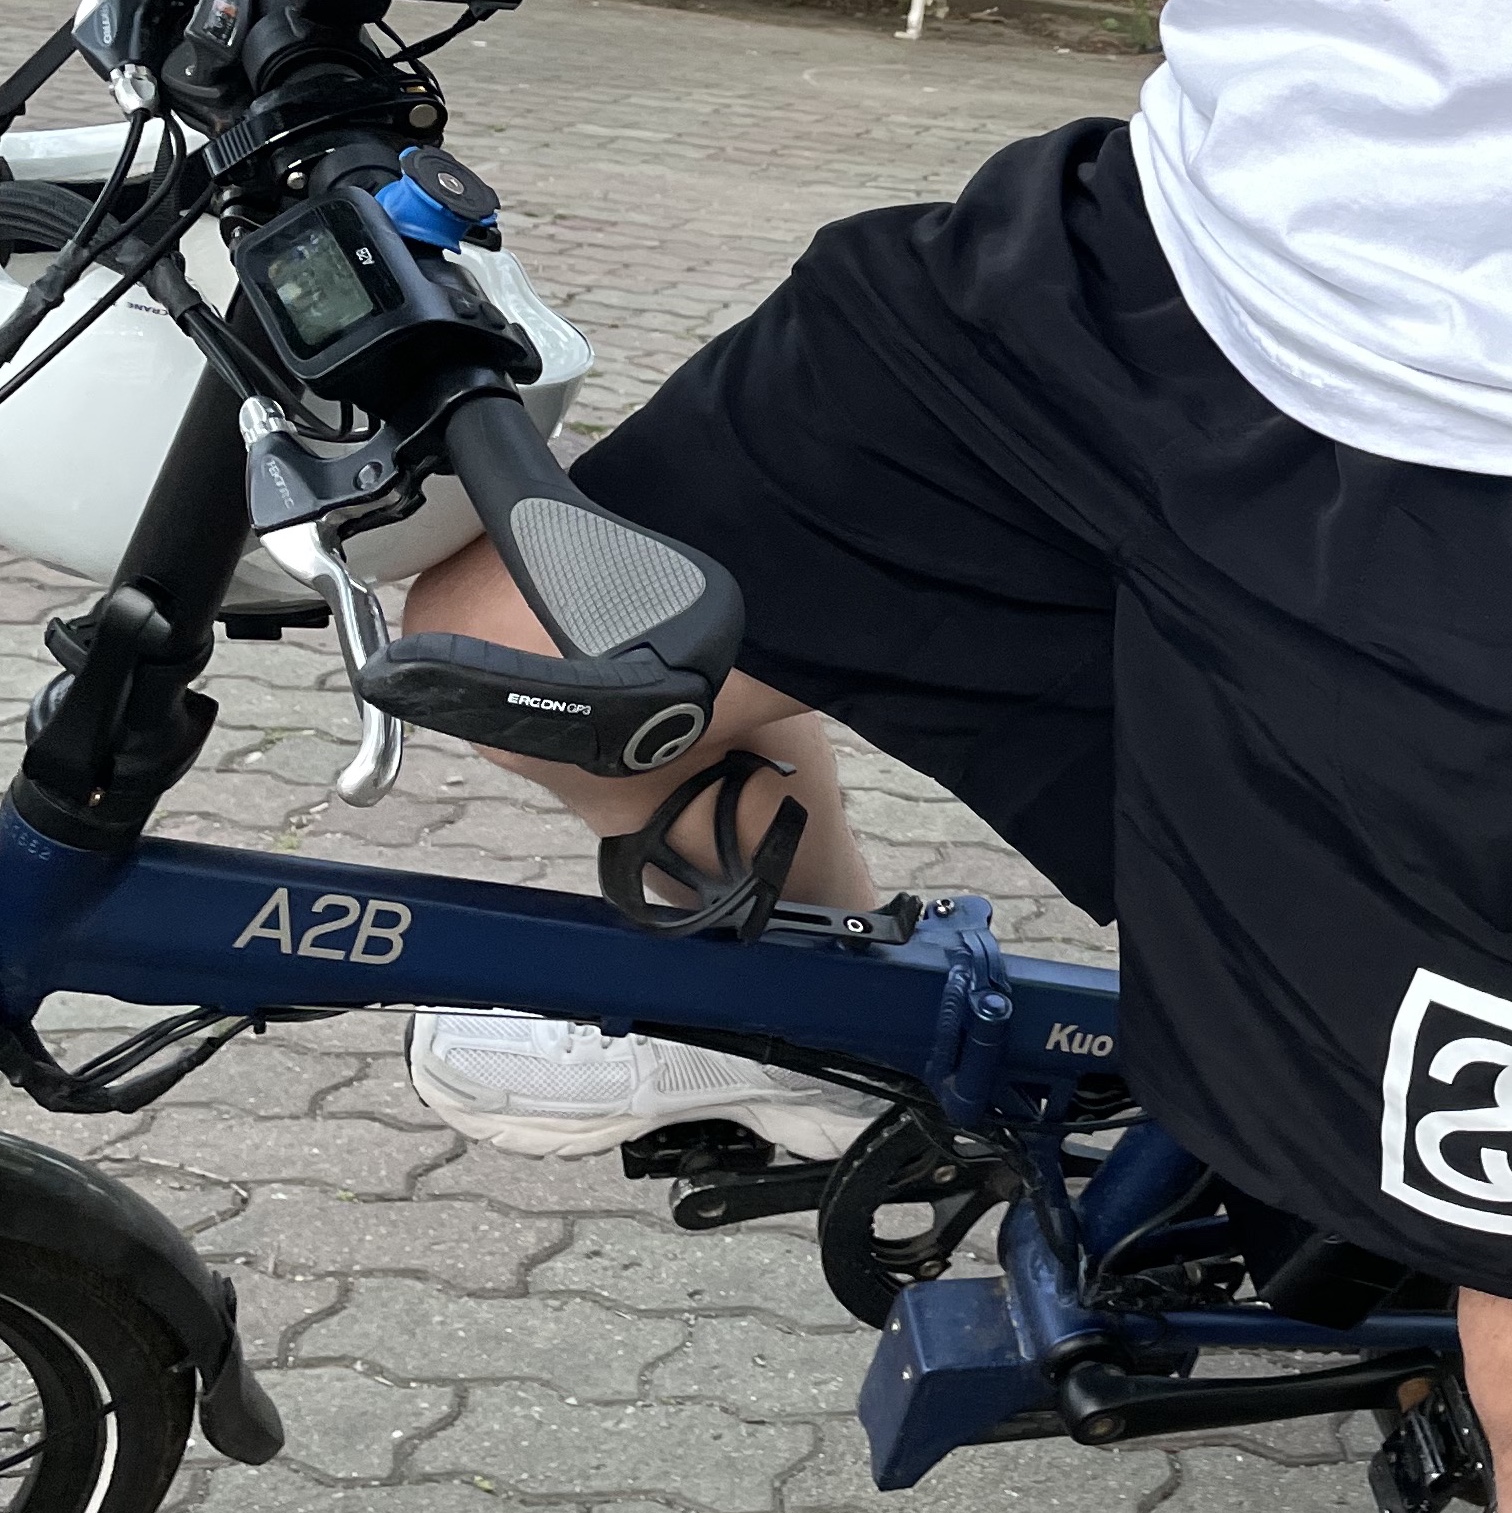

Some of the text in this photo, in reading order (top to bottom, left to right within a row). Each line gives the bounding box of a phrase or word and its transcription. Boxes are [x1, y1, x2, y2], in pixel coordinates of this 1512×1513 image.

[355, 246, 375, 265] A2B
[507, 692, 567, 712] ERGON
[233, 887, 412, 965] A2B
[1046, 1022, 1114, 1057] Kuo
